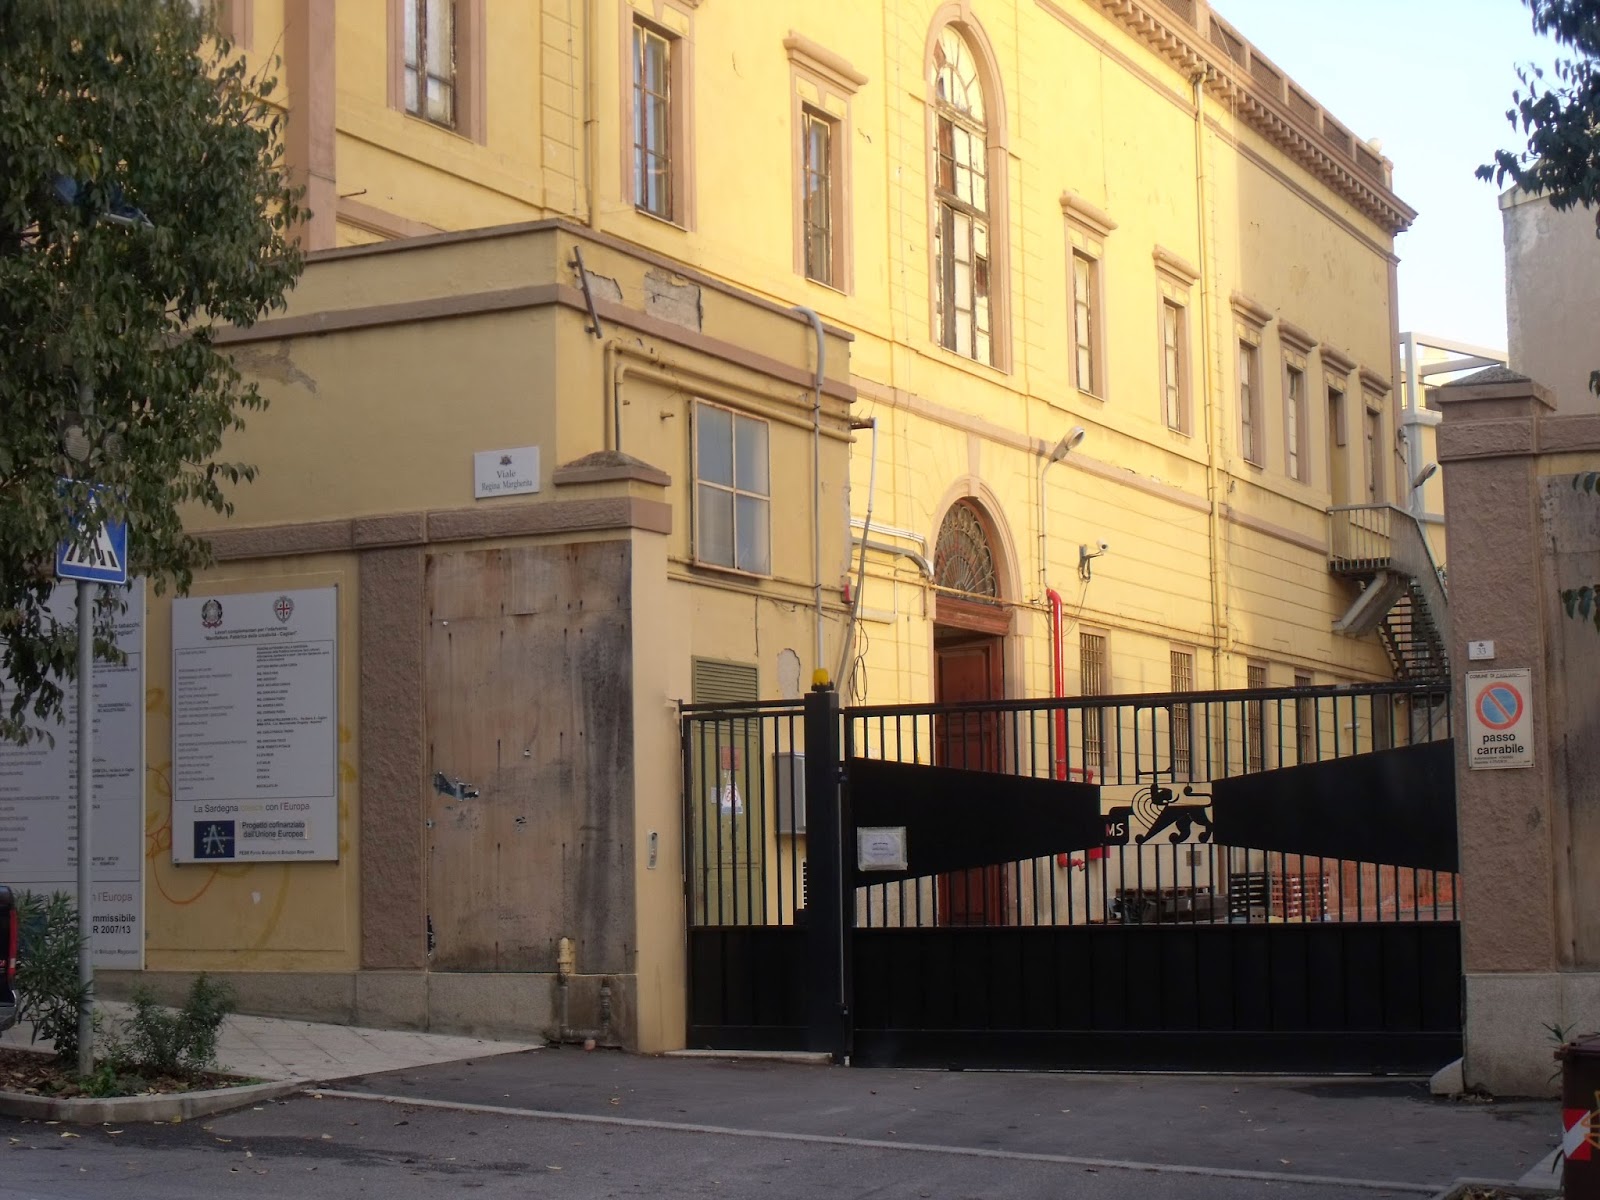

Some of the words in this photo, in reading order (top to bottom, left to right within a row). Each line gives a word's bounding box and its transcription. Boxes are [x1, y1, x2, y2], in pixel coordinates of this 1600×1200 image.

[496, 469, 516, 478] Viale
[481, 482, 501, 492] Regina
[502, 479, 533, 490] Margherita
[1476, 647, 1487, 656] 33
[1482, 733, 1516, 745] passo
[1476, 743, 1524, 755] carrabile
[193, 804, 203, 813] La
[204, 804, 239, 815] Sardegna
[265, 803, 279, 811] con
[280, 802, 310, 812] l'Europa
[242, 821, 267, 831] Progetto
[268, 821, 306, 829] cofinanziato
[243, 830, 277, 838] dall'Unione
[277, 829, 304, 839] Europea
[97, 891, 133, 904] l'Europa
[92, 913, 136, 923] mmissibile
[92, 925, 99, 934] R
[101, 925, 131, 935] 2007/13
